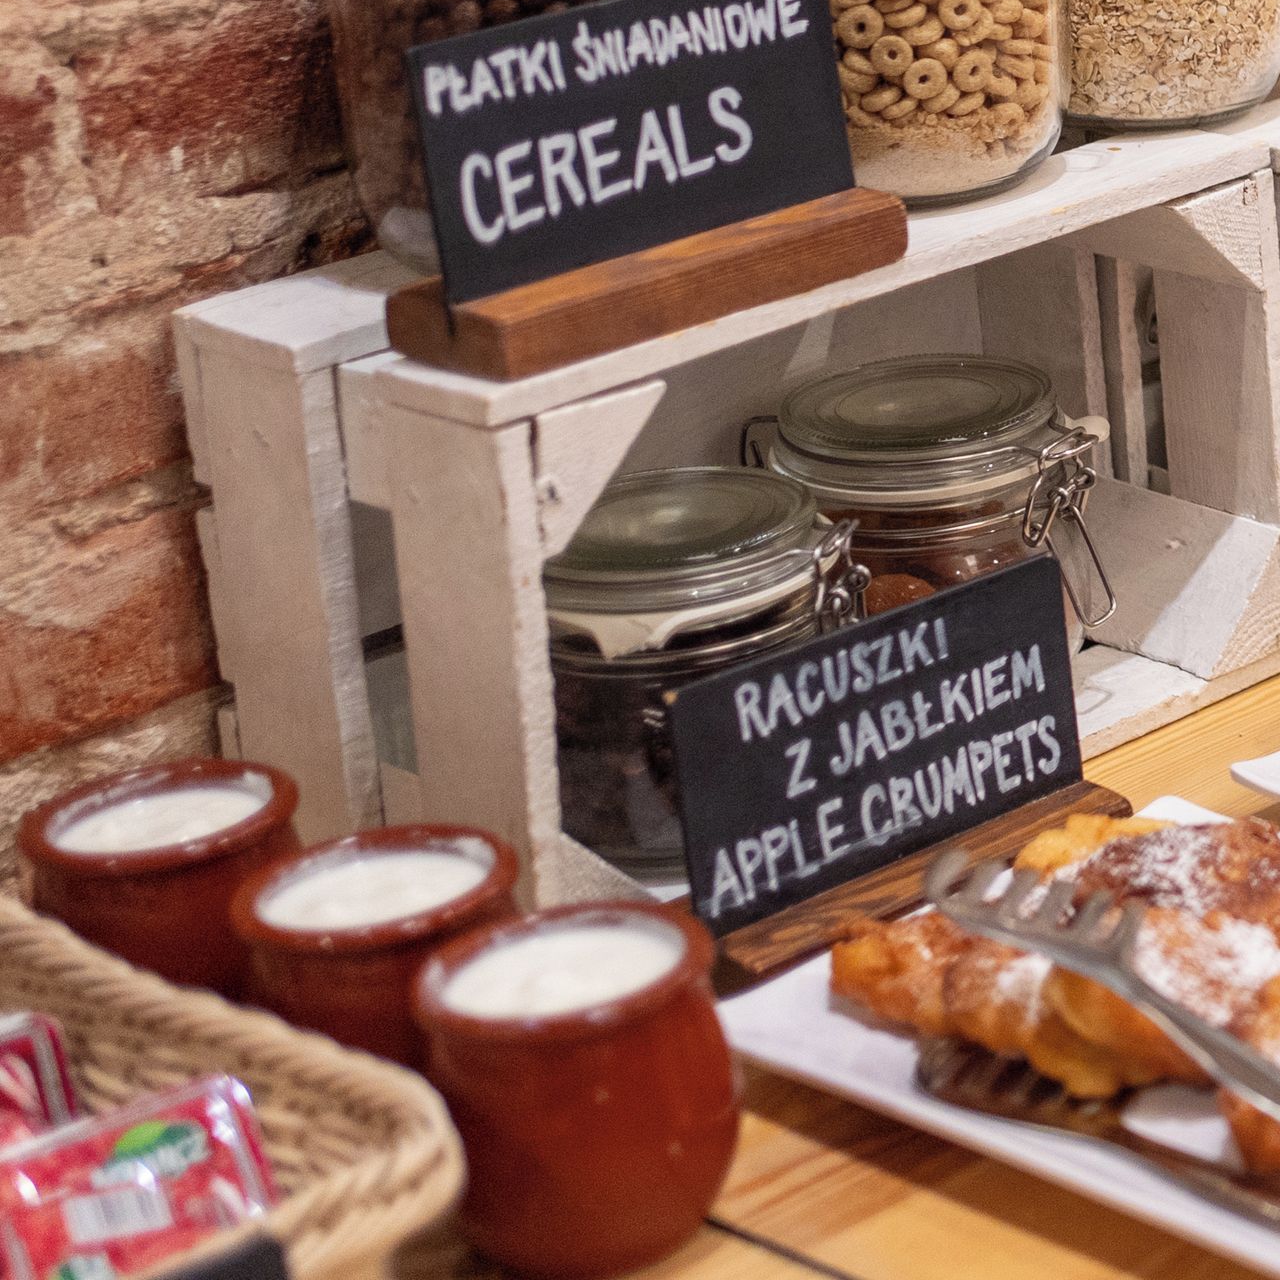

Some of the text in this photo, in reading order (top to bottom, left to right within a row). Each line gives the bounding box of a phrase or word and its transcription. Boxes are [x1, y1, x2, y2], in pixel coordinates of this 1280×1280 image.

[424, 35, 567, 116] PŁATKI
[459, 85, 754, 247] CEREALS
[734, 618, 950, 743] RACUSZKI
[784, 643, 1046, 800] Z JABŁKIEM
[708, 714, 1062, 919] APPLE CRUMPETS
